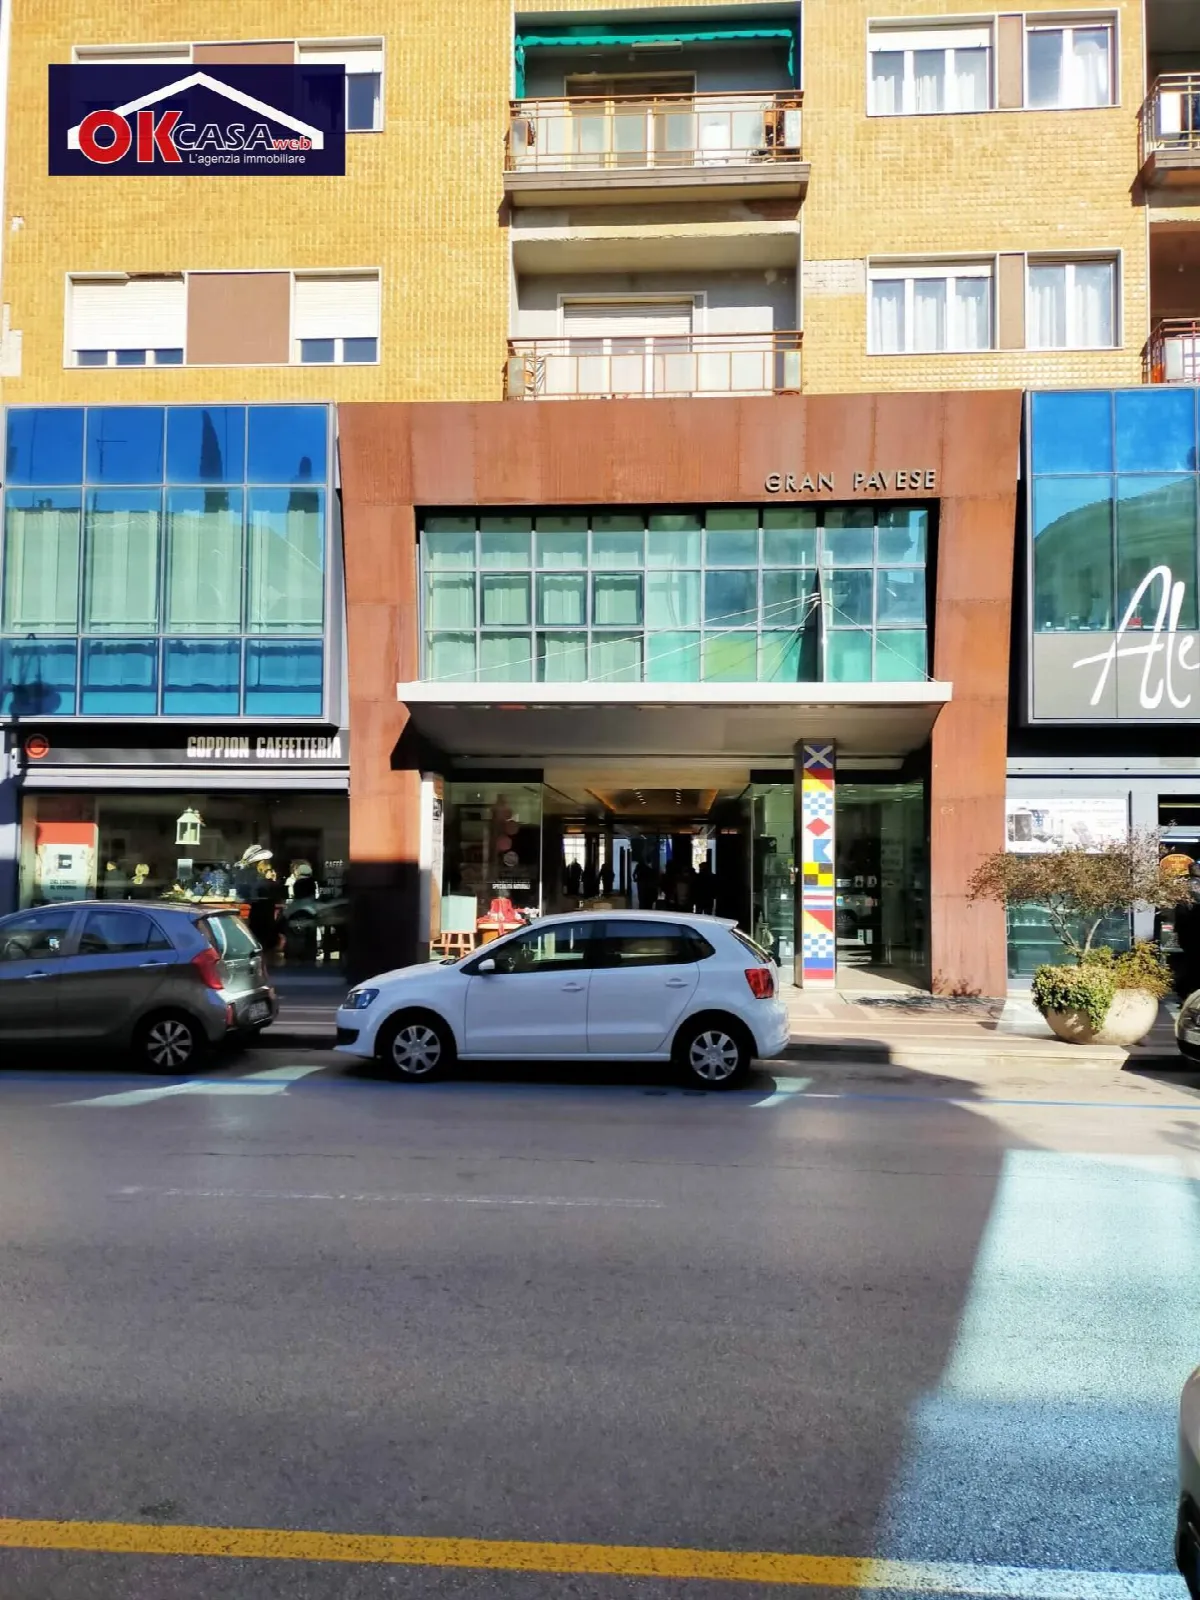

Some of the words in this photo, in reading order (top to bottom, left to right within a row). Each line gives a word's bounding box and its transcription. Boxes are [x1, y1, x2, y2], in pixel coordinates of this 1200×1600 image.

[765, 471, 835, 493] GRAN
[852, 468, 937, 491] PAVESE
[186, 736, 250, 758] GOPPION
[256, 736, 342, 759] CAFFETTERIA
